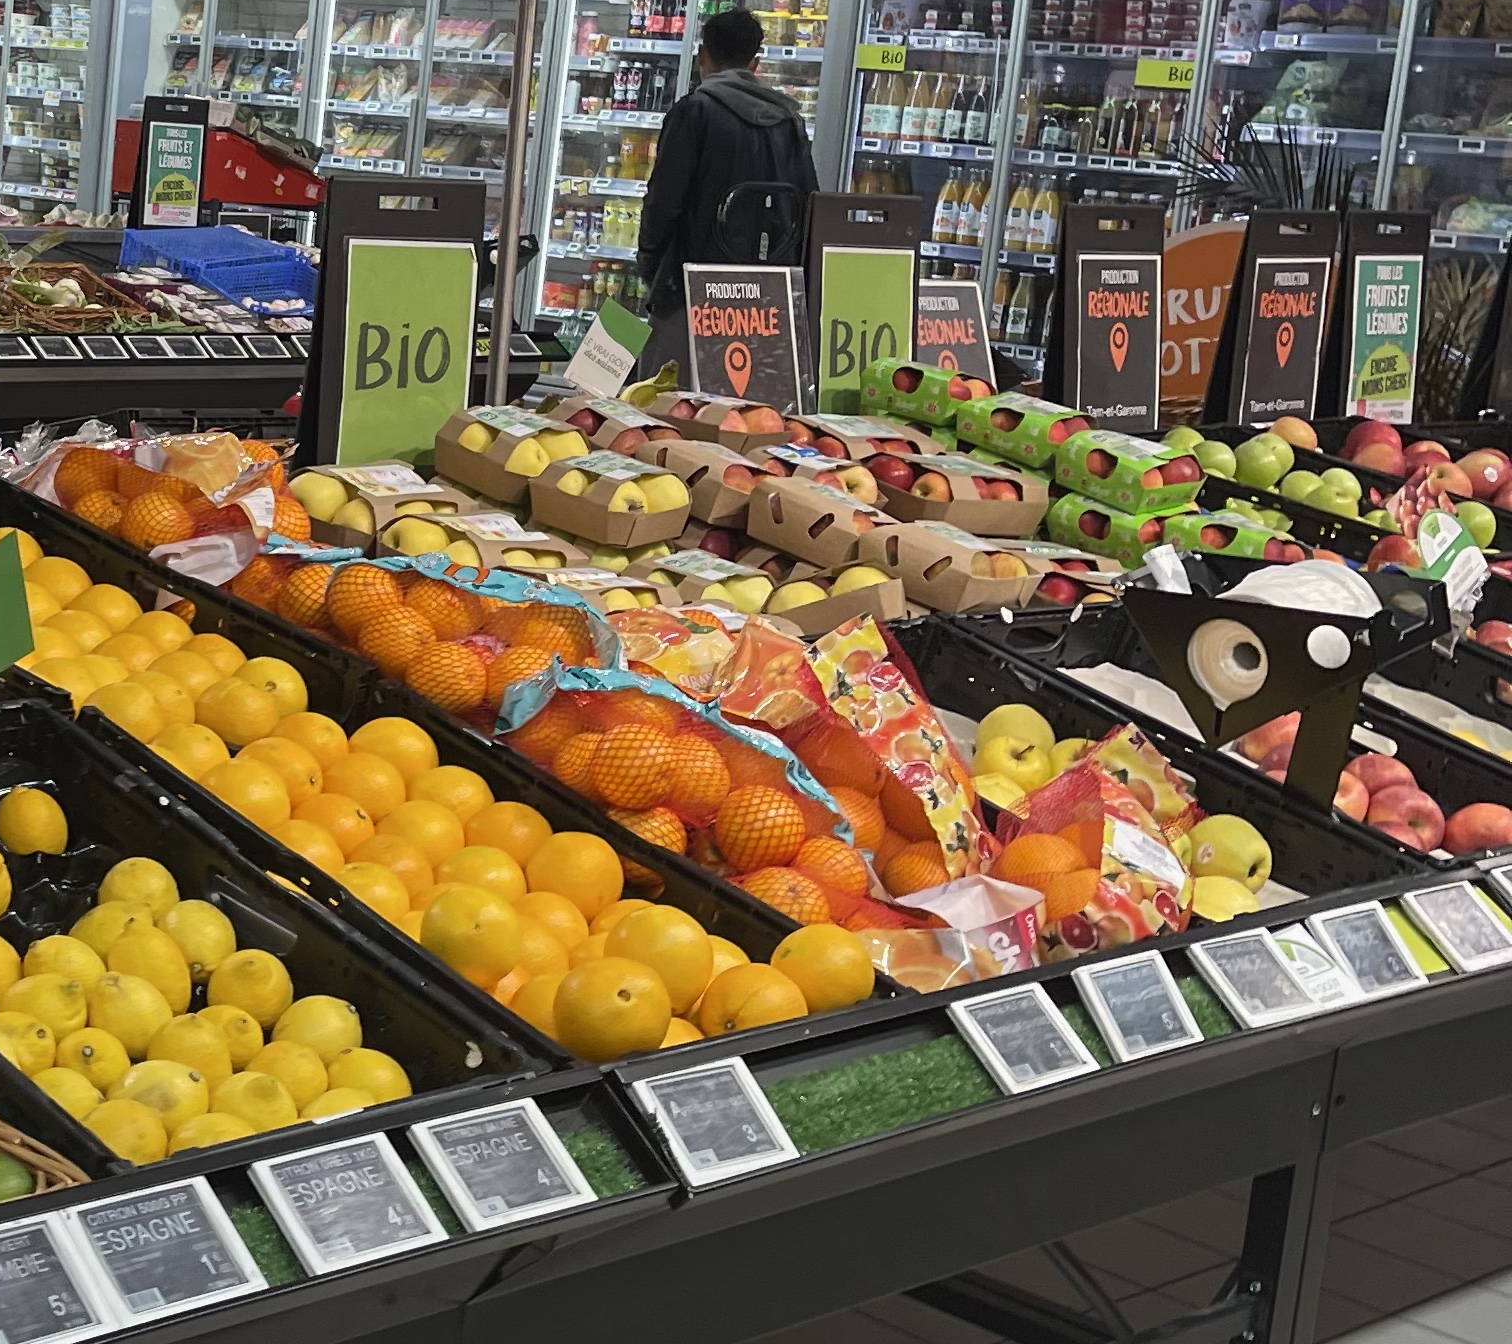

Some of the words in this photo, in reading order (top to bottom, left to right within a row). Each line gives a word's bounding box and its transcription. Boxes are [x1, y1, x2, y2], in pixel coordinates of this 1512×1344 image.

[158, 138, 183, 153] FRUITS
[184, 140, 194, 154] ET
[705, 282, 761, 300] PRODUCTION
[1100, 269, 1140, 285] PRODUCTION
[1273, 272, 1310, 286] PRODUCTION
[1088, 287, 1150, 319] RÉGIONALE
[1258, 288, 1317, 318] RÉGIONALE
[1365, 284, 1398, 308] FRUITS
[1398, 284, 1411, 307] ET
[691, 302, 781, 337] RÉGIONALE
[917, 317, 977, 346] ÉGIONALE
[1366, 308, 1409, 336] LÉGUMES
[445, 1131, 533, 1167] ESPAGNE
[286, 1166, 384, 1207] ESPAGNE
[85, 1204, 137, 1227] CITRON
[91, 1210, 201, 1256] ESPAGNE
